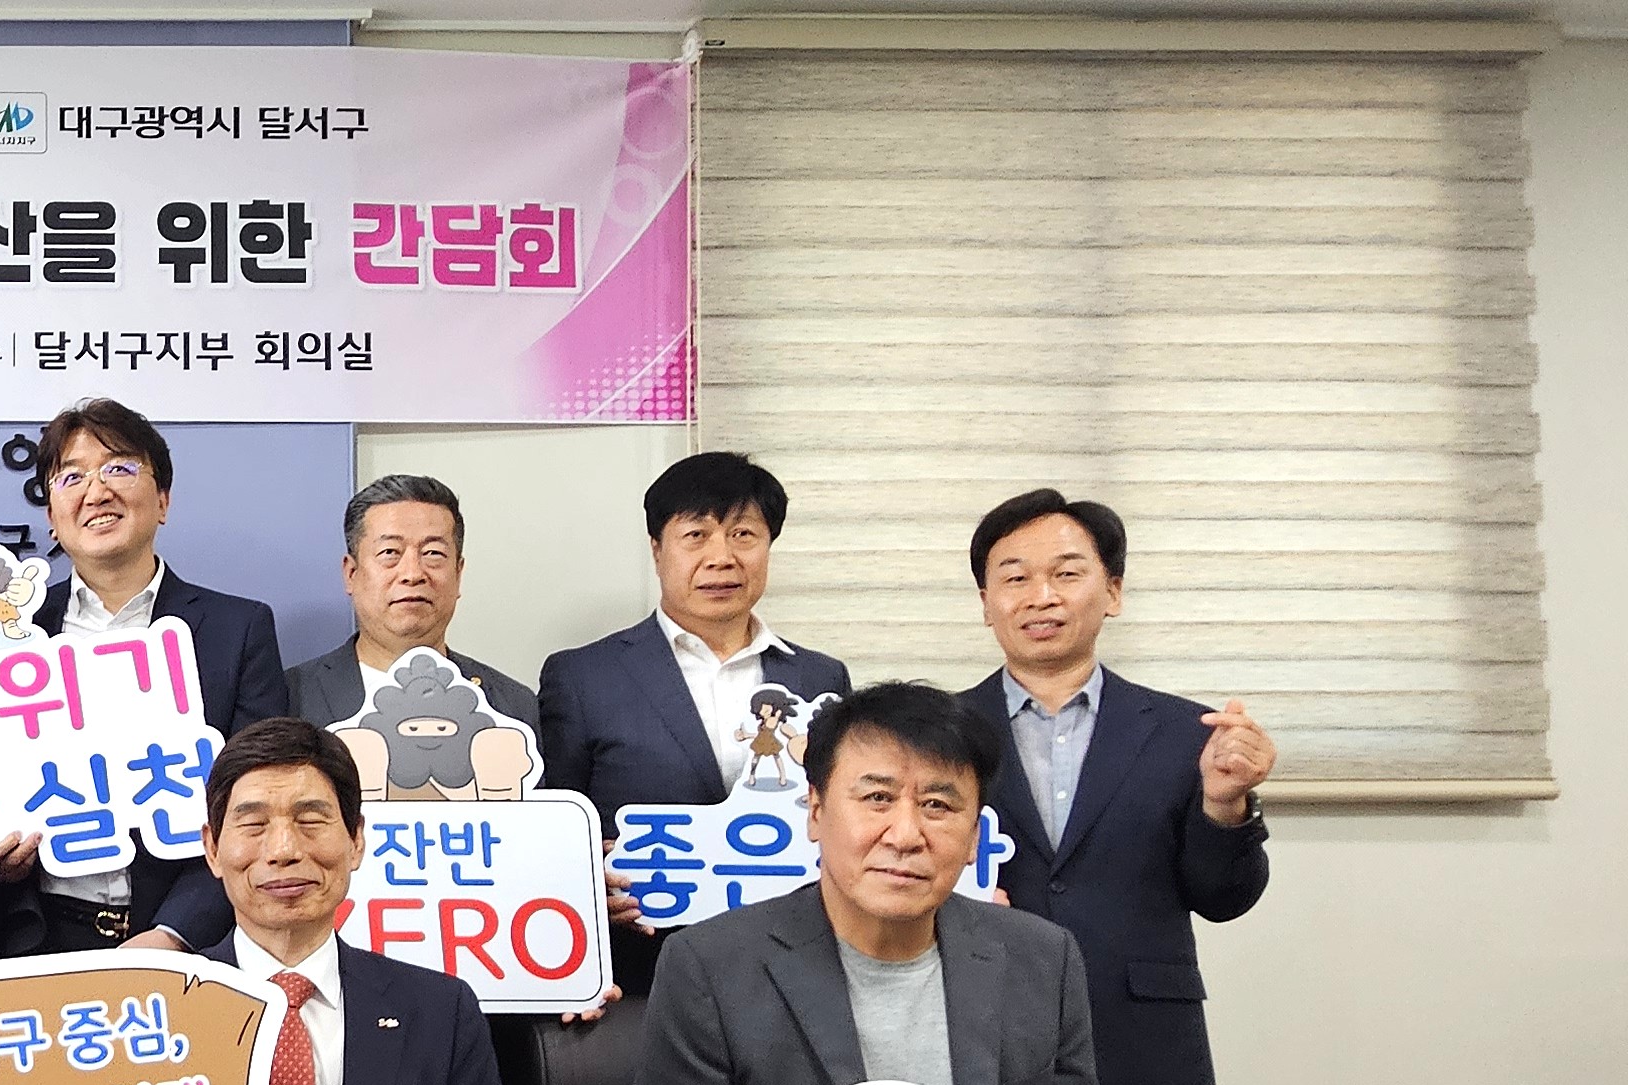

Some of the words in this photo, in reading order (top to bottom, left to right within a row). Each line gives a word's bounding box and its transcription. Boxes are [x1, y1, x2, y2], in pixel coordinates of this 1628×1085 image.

[59, 105, 240, 140] 대구광역시
[258, 106, 369, 140] 달서구
[156, 199, 313, 284] 위한
[353, 203, 576, 288] 간담회
[34, 331, 234, 371] 달서구지부
[254, 330, 373, 371] 회의실
[24, 737, 225, 863] 실천
[372, 821, 501, 886] 잔반
[62, 999, 185, 1067] 중심,
